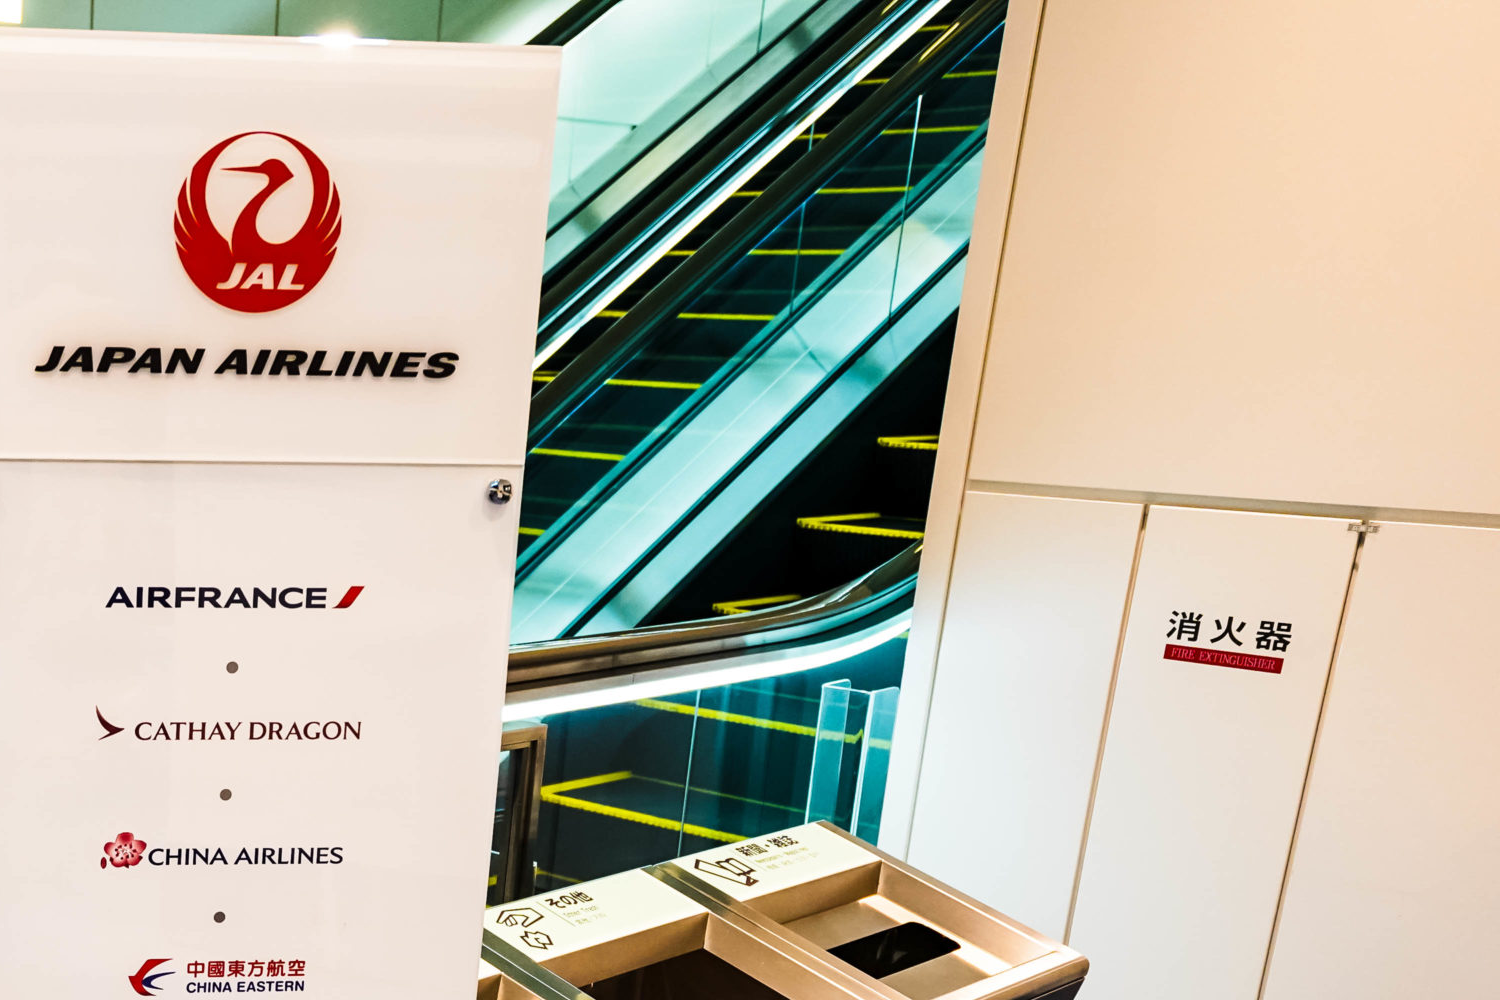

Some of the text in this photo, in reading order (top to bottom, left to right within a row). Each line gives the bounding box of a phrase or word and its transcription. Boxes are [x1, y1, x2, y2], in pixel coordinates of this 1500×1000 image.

[215, 262, 305, 291] JAL
[34, 345, 460, 380] JAPAN AIRLINES
[105, 586, 328, 610] AIRFRANCE
[1166, 610, 1293, 653] 消火器
[1170, 646, 1276, 671] FIRE EXTINGUISHER
[134, 720, 362, 741] CATHAY DRAGON
[148, 846, 344, 866] CHINA AIRLINES
[544, 890, 595, 909] その他
[186, 958, 307, 979] 中國東方航空
[186, 979, 306, 994] CHINA EASTERN
